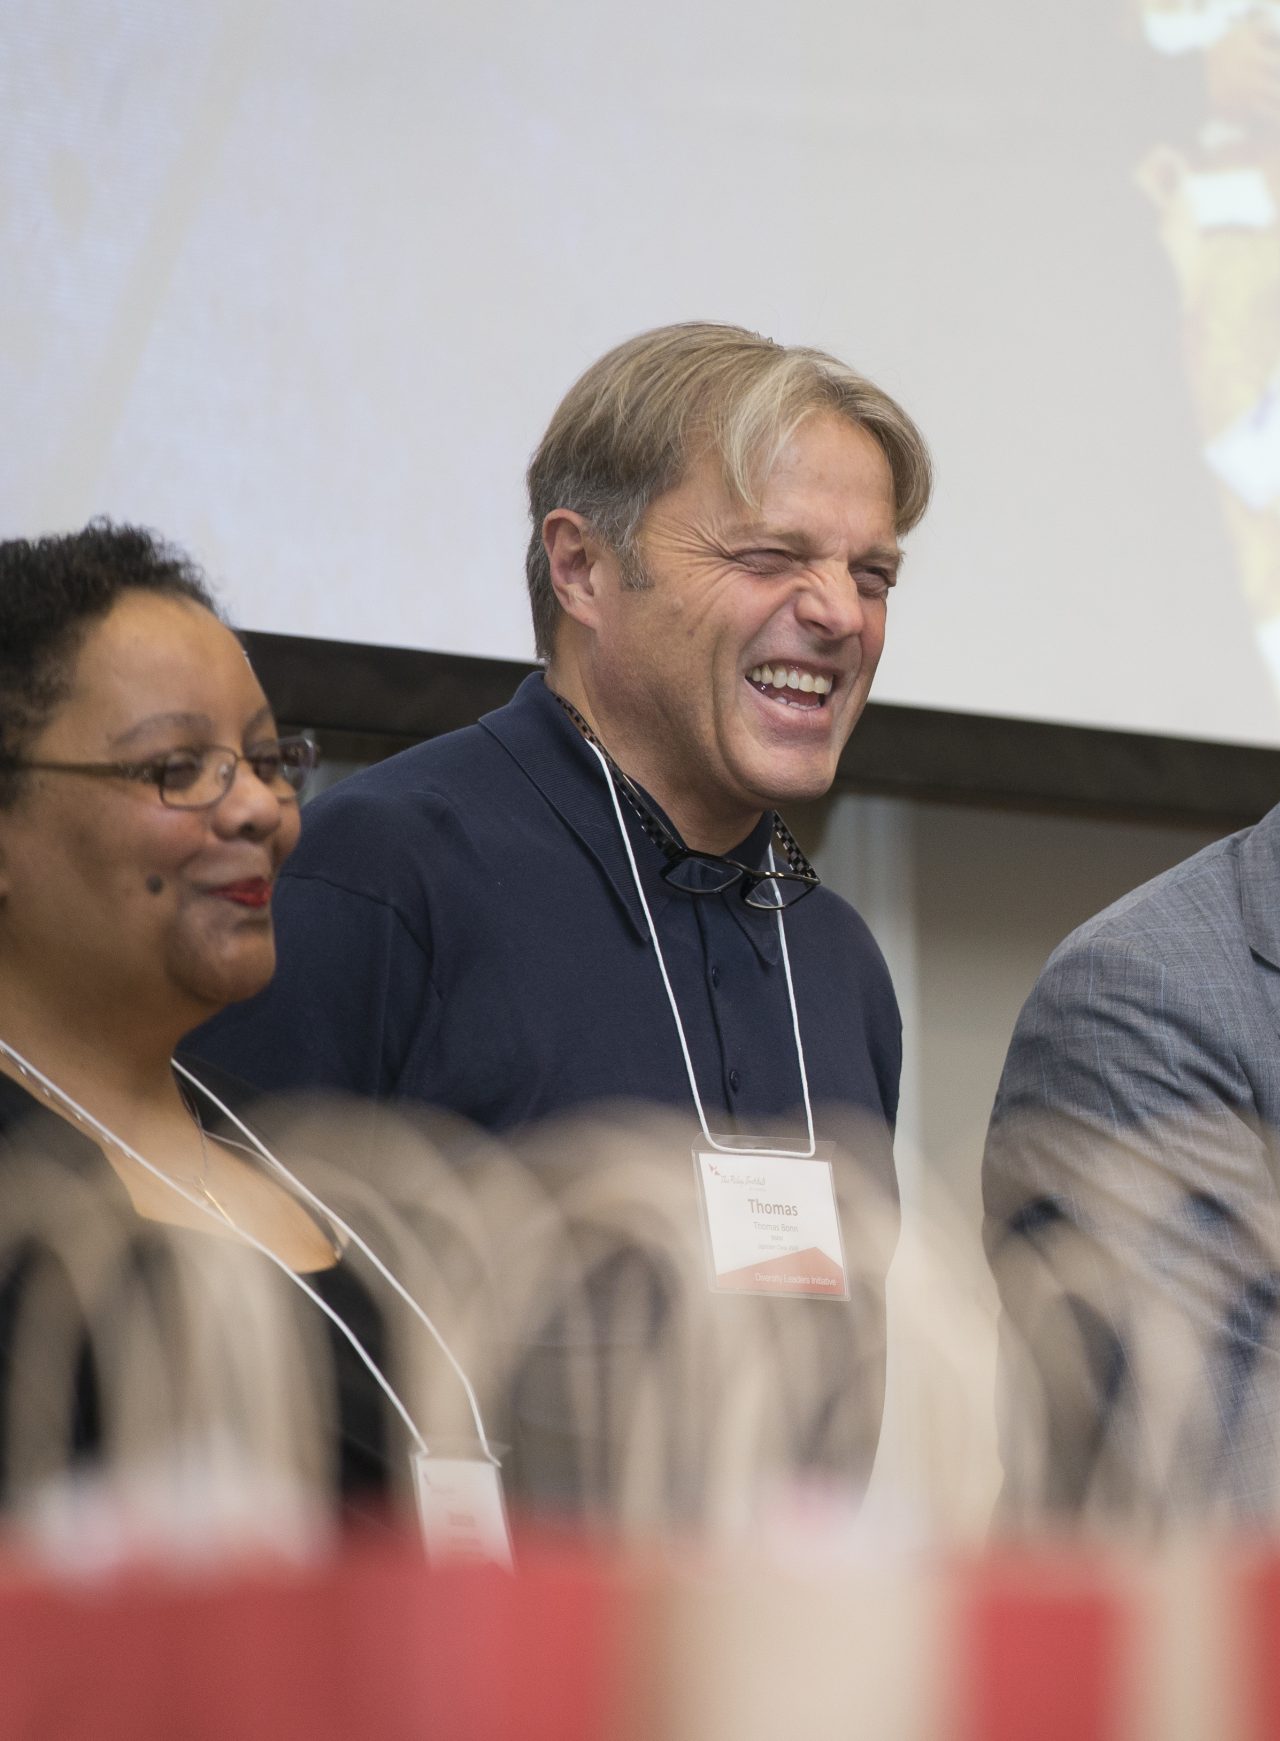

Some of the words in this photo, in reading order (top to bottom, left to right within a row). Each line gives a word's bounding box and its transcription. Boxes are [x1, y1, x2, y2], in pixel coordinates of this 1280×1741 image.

[747, 1198, 799, 1217] Thomas
[753, 1221, 780, 1232] Thomas
[754, 1272, 782, 1285] Diversity
[783, 1274, 810, 1285] Leaders
[811, 1275, 837, 1287] Initiative
